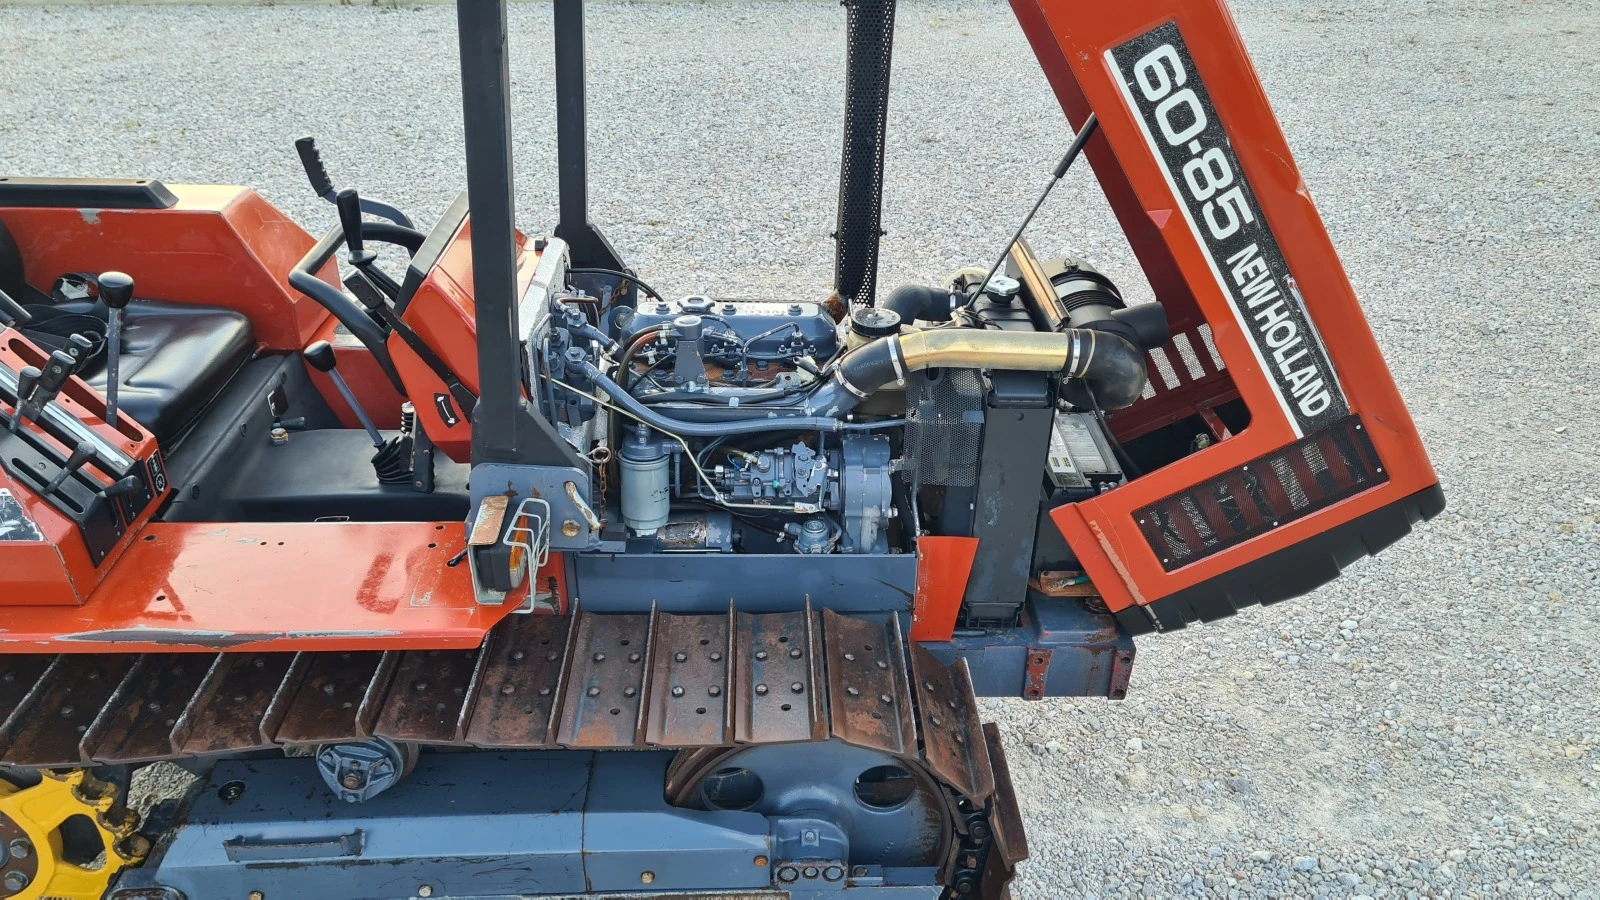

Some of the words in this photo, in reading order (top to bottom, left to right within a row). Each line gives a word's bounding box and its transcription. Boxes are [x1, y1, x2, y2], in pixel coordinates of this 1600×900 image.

[1134, 44, 1254, 239] 60-85
[1226, 243, 1277, 308] NEW
[1254, 299, 1331, 417] HOLLAND
